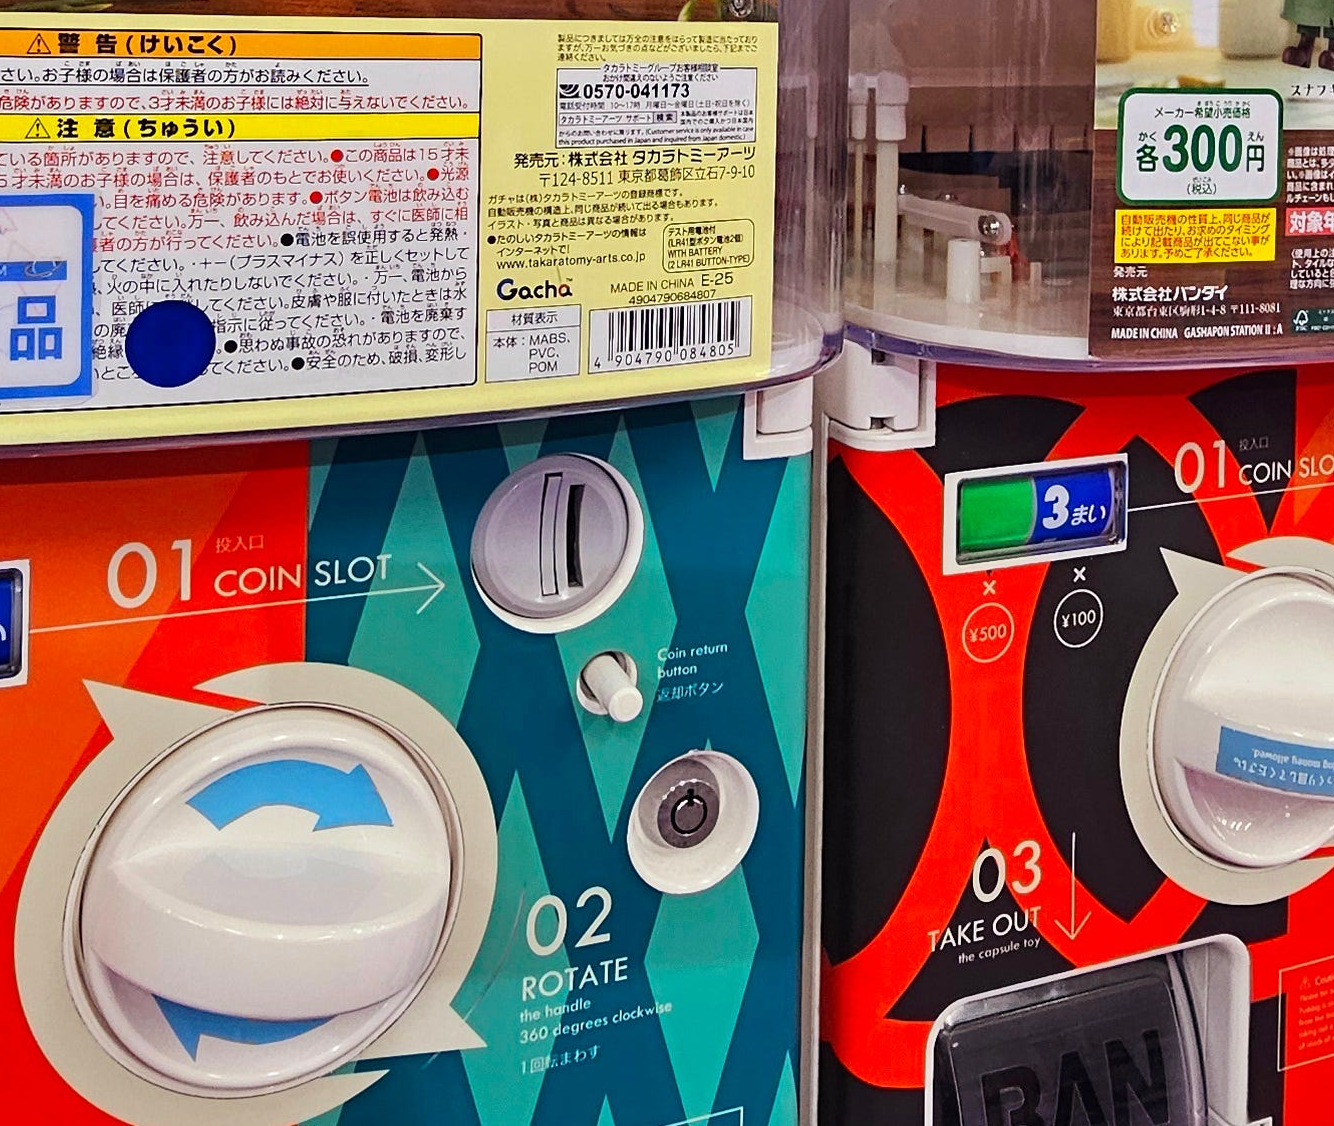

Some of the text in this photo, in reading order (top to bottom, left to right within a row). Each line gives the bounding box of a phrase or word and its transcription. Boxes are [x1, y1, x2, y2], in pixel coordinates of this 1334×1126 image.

[583, 83, 691, 100] 0570-041173
[1154, 106, 1251, 120] メーカー希望小売価格
[631, 146, 756, 165] タカラトミーアーツ
[618, 165, 756, 184] 東京都葛飾区立石7-9-10
[667, 245, 723, 257] WITH BATTERY
[496, 251, 646, 271] www.takaratomy-arts.co.jp
[1113, 265, 1148, 278] 発売元
[610, 271, 734, 294] MADE IN CHINA E-25
[628, 288, 717, 304] 4904790684807
[1111, 284, 1229, 303] 株式会社バンダイ
[511, 310, 559, 326] 材質表示
[1110, 327, 1137, 340] MADE
[1151, 327, 1179, 339] CHINA
[1184, 325, 1229, 338] GASHAPON
[1230, 323, 1263, 337] STATION
[679, 343, 735, 361] 084805
[528, 360, 559, 373] POM
[1174, 439, 1226, 494] 01
[1238, 460, 1293, 486] COIN
[107, 539, 392, 611] 01 COIN SLOT
[1062, 608, 1097, 628] ¥100
[968, 623, 1008, 642] ¥500
[657, 642, 728, 662] Coin return
[657, 665, 698, 680] button
[972, 839, 1042, 903] 03
[526, 885, 613, 958] 02
[927, 905, 1042, 953] TAKE OUT
[958, 937, 1041, 964] the capsule toy
[521, 955, 629, 1002] ROTATE
[520, 997, 592, 1023] the handle
[519, 1001, 673, 1044] 360 degrees clockwise
